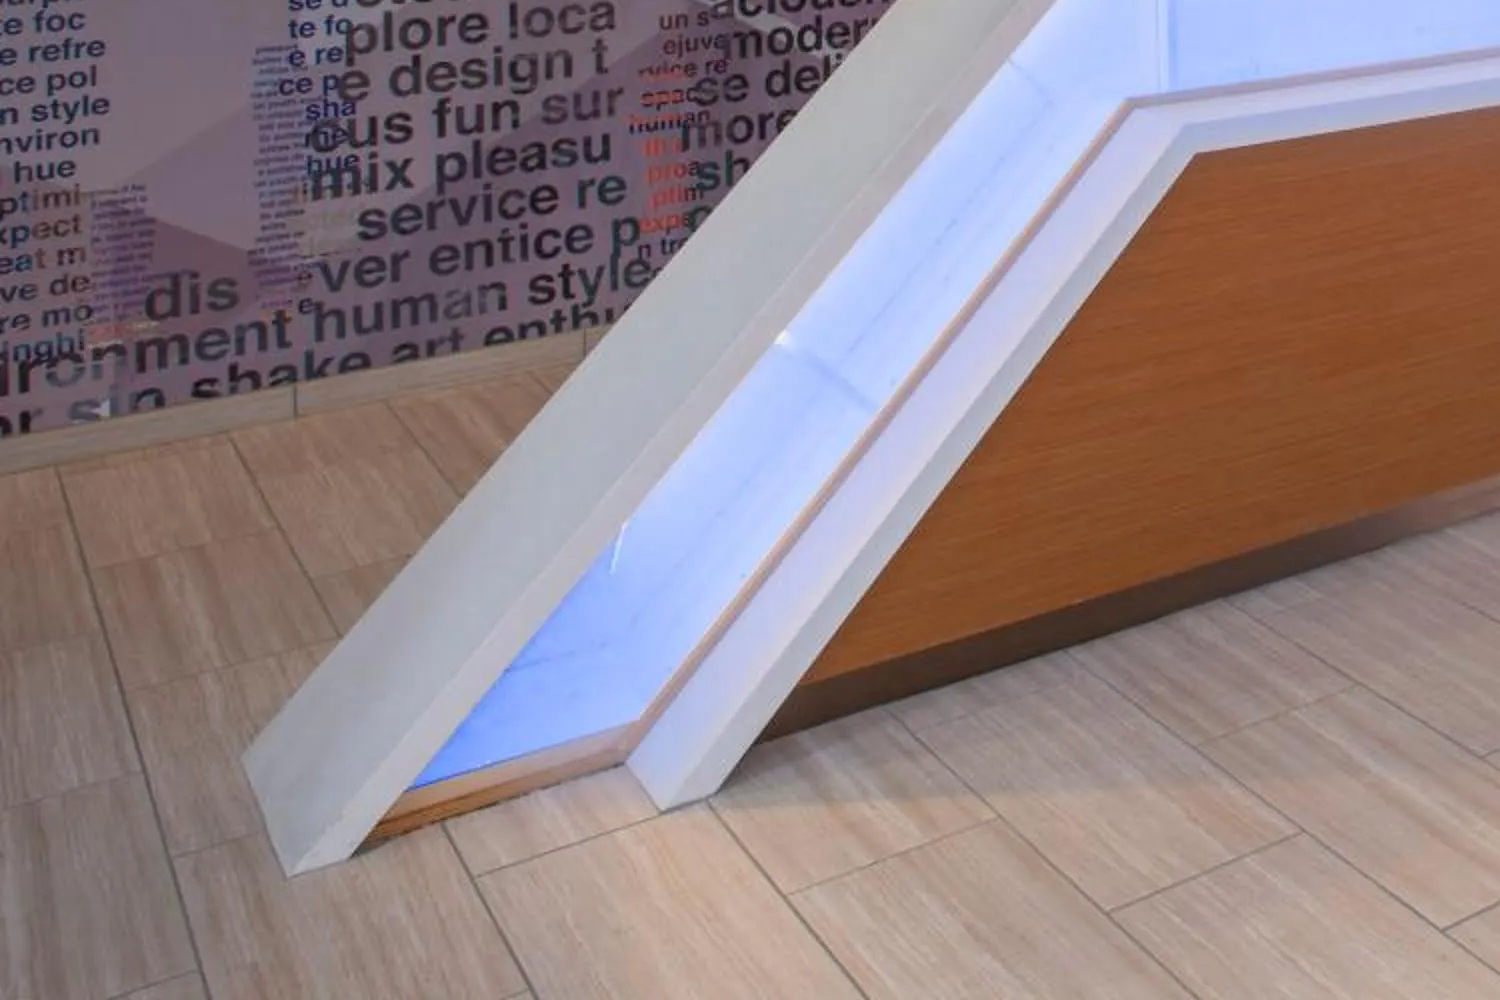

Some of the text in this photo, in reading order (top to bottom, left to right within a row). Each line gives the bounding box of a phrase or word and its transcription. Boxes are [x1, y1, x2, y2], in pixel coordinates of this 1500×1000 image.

[32, 9, 86, 33] foc
[288, 18, 317, 38] te
[344, 0, 615, 67] plore loca
[28, 37, 106, 64] refre
[46, 64, 97, 98] pol
[339, 69, 371, 101] e
[388, 45, 573, 98] design
[591, 35, 608, 75] t
[279, 77, 314, 96] ce
[31, 94, 110, 125] style
[305, 97, 356, 121] sha
[432, 95, 520, 139] fun
[541, 86, 625, 125] sur
[13, 160, 77, 185] hue
[435, 133, 611, 196] pleasu
[357, 183, 560, 242] service
[577, 173, 628, 210] re
[318, 248, 412, 293] ver
[428, 222, 596, 277] entice
[49, 272, 91, 297] de
[144, 268, 240, 321] dis
[313, 254, 653, 343] human style
[41, 302, 94, 328] mo
